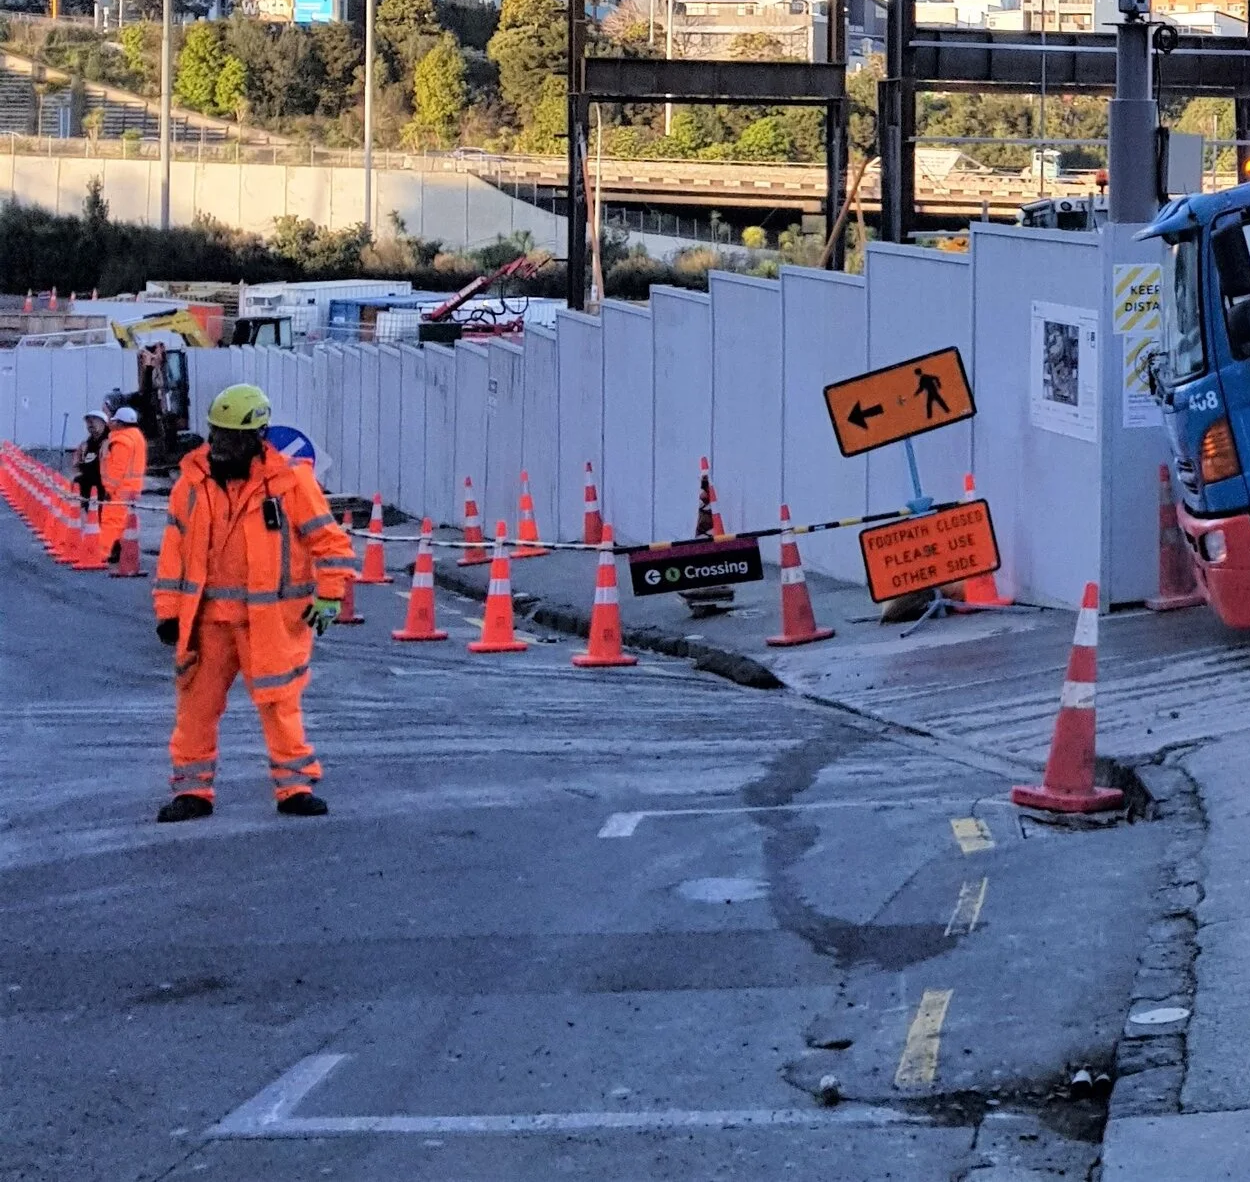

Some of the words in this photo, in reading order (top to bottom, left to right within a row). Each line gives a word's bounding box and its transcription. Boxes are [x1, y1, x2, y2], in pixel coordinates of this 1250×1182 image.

[868, 526, 929, 551] FOOTPATH
[936, 509, 983, 533] CLOSED
[884, 542, 940, 568] PLEASE
[948, 532, 976, 551] USE
[684, 560, 749, 579] Crossing
[891, 565, 938, 588] OTHER
[946, 554, 978, 573] SIDE
